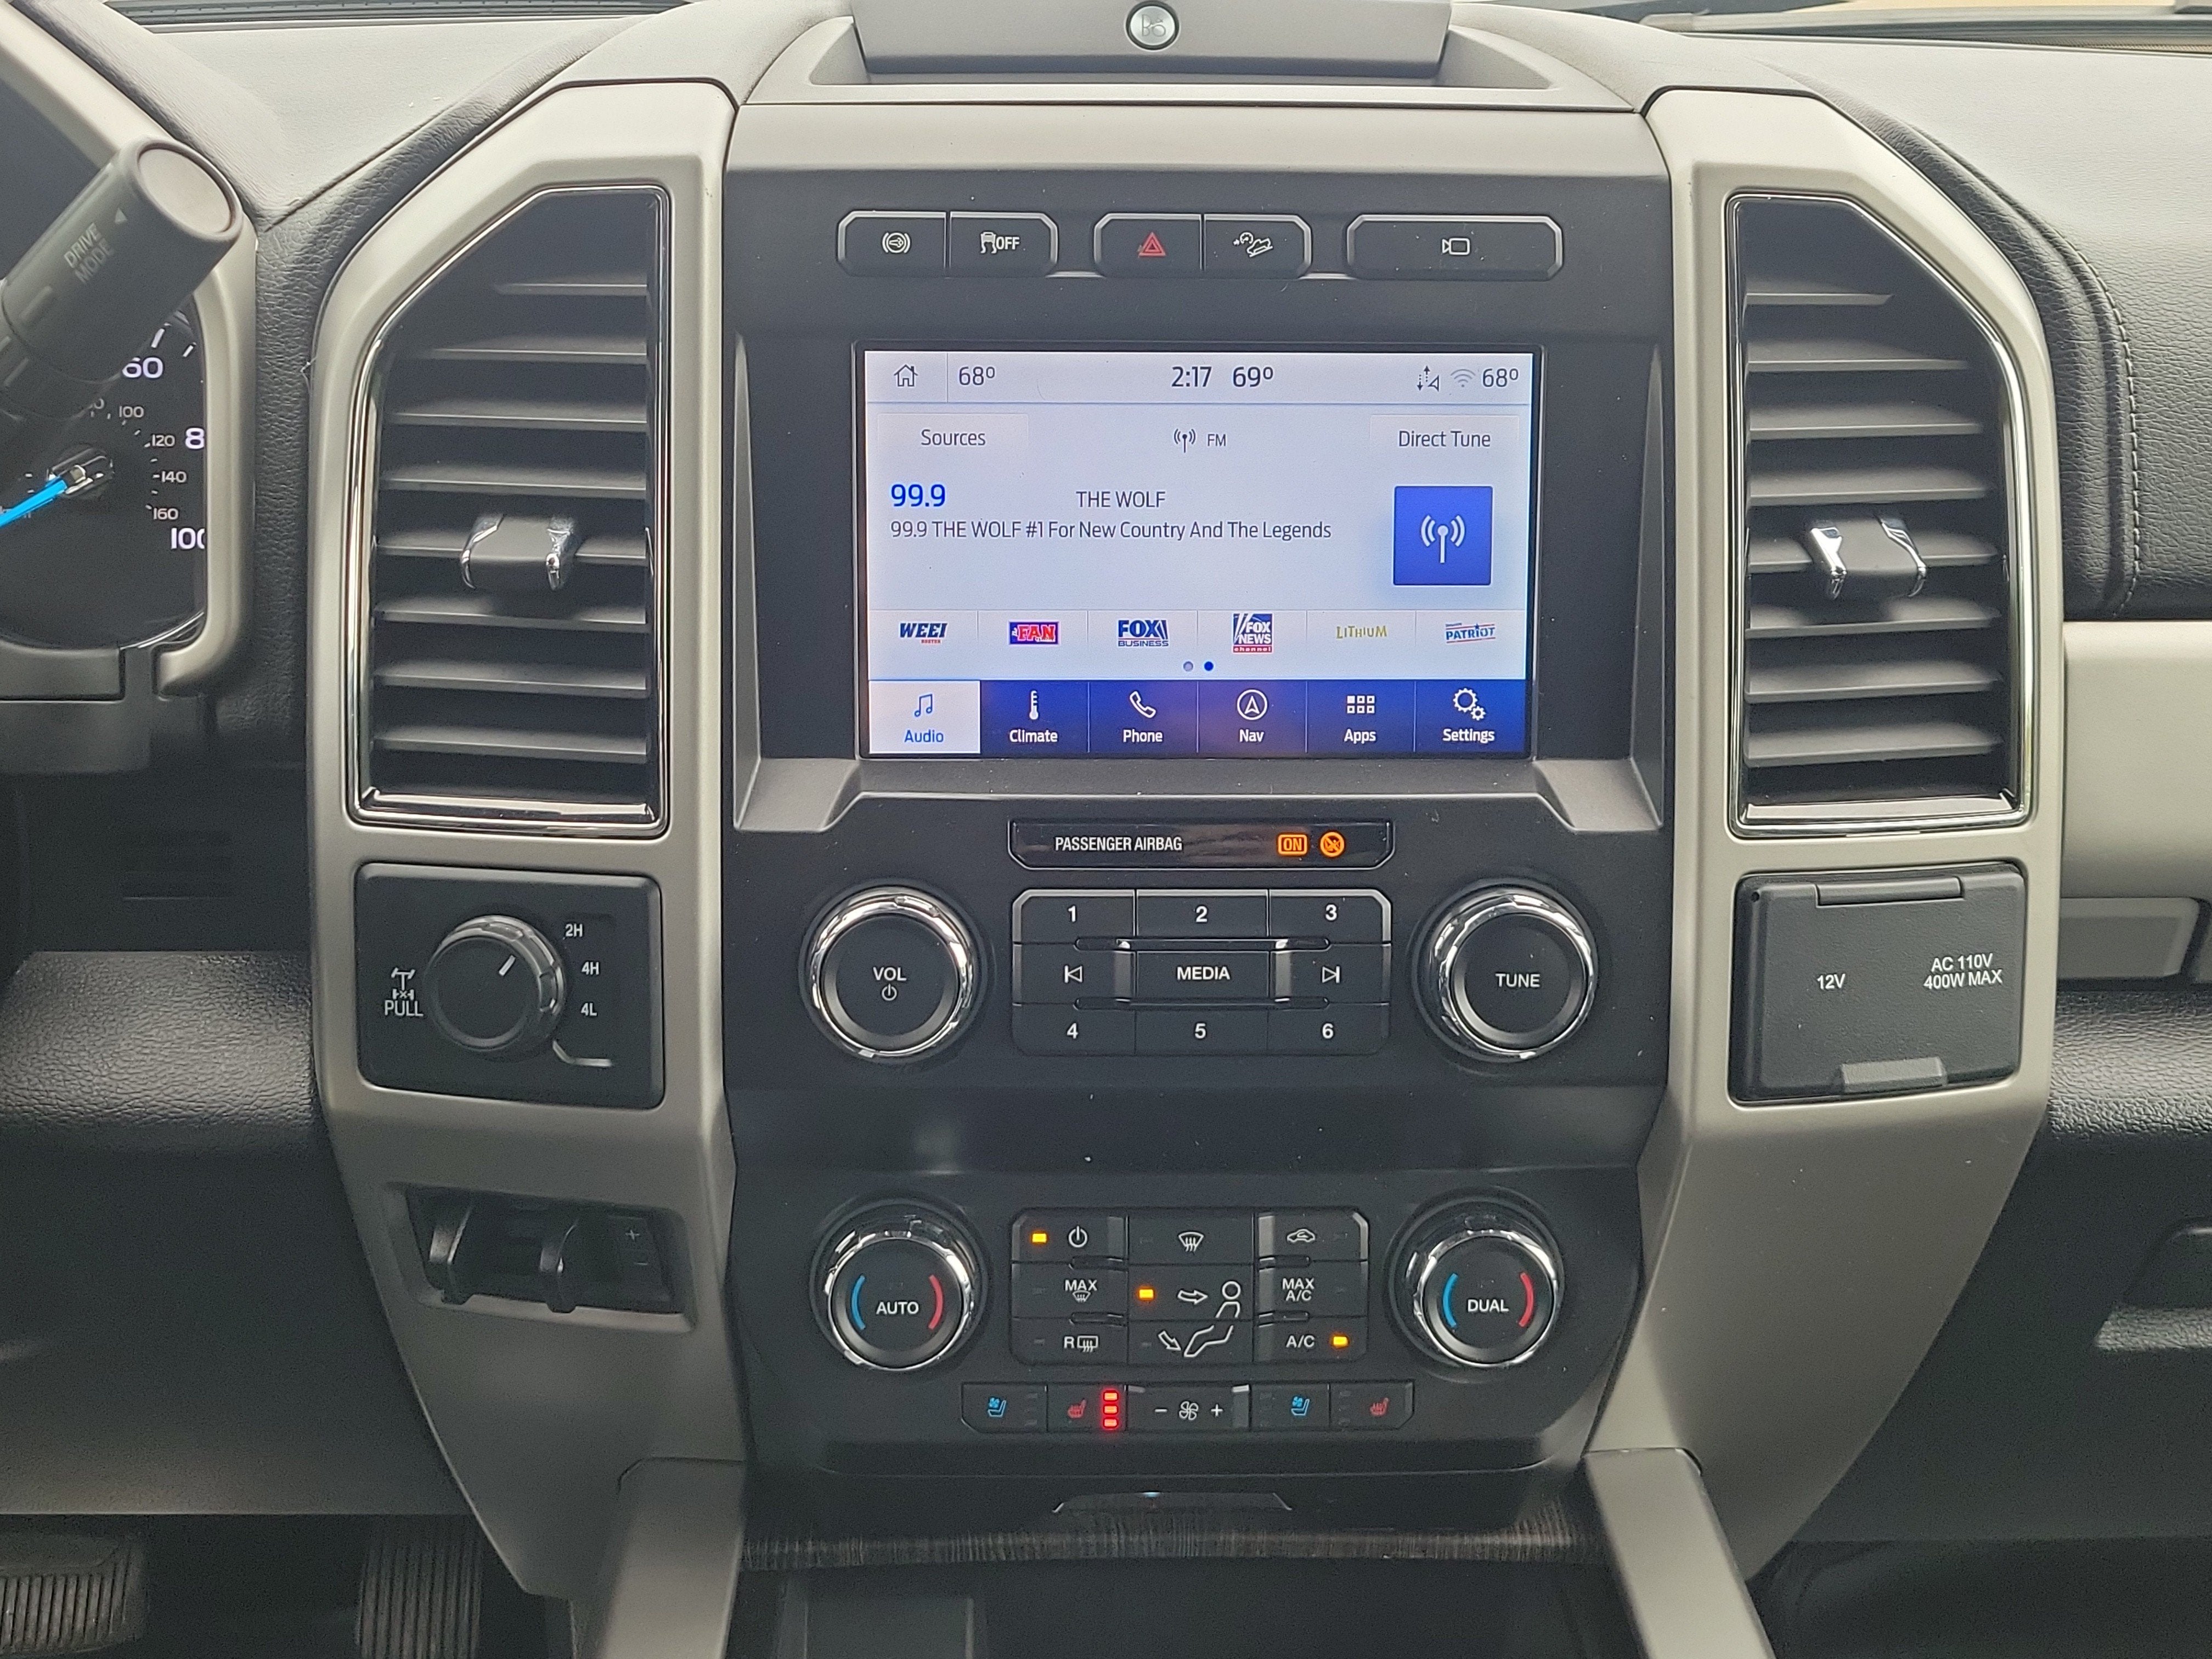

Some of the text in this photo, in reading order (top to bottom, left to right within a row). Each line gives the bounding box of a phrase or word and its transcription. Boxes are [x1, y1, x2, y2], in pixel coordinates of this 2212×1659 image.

[64, 223, 102, 268] DRIVE
[996, 236, 1020, 250] OFF
[76, 240, 112, 283] MODE
[122, 357, 163, 378] 60
[1172, 366, 1211, 387] 2:17
[120, 406, 144, 417] 100
[153, 435, 174, 446] 120
[922, 430, 985, 445] Sources
[1208, 434, 1226, 446] FM
[1400, 431, 1490, 447] Direct Tune
[162, 471, 186, 482] 140
[891, 484, 945, 506] 99.9
[1076, 492, 1165, 507] THE WOLF
[154, 509, 178, 519] 160
[891, 521, 1331, 541] 99.9 THE WOLF #1 For New Country And The Legends
[900, 623, 947, 637] WEEI
[1018, 625, 1056, 641] FAN
[1119, 620, 1159, 637] FOX
[1246, 622, 1271, 633] FOX
[1336, 625, 1387, 639] LITHIUM
[1238, 634, 1271, 644] NEWS
[905, 730, 943, 742] Audio
[1010, 729, 1057, 742] Climate
[1124, 729, 1162, 742] Phone
[1240, 729, 1264, 742] Nav
[1344, 729, 1375, 744] Apps
[1443, 729, 1494, 743] Settings
[1056, 837, 1182, 850] PASSENGER AIRBAG
[1283, 838, 1302, 851] ON
[1069, 906, 1075, 922] 1
[1197, 906, 1207, 922] 2
[1326, 905, 1336, 920] 3
[565, 923, 583, 937] 2H
[582, 962, 599, 974] 4H
[1931, 953, 1993, 971] AC 110V
[873, 967, 906, 980] VOL
[1178, 967, 1230, 979] MEDIA
[1923, 970, 2002, 989] 400W MAX
[1496, 974, 1539, 987] TUNE
[1818, 974, 1845, 989] 12V
[385, 1000, 423, 1016] PULL
[581, 1003, 597, 1015] 4L
[1067, 1023, 1077, 1038] 4
[1195, 1024, 1205, 1038] 5
[1323, 1024, 1333, 1038] 6
[1065, 1280, 1097, 1291] MAX
[1283, 1278, 1314, 1289] MAX
[1286, 1290, 1311, 1301] A/C
[877, 1302, 918, 1314] AUTO
[1468, 1300, 1509, 1312] DUAL
[1064, 1336, 1074, 1348] R
[1286, 1335, 1314, 1347] A/C
